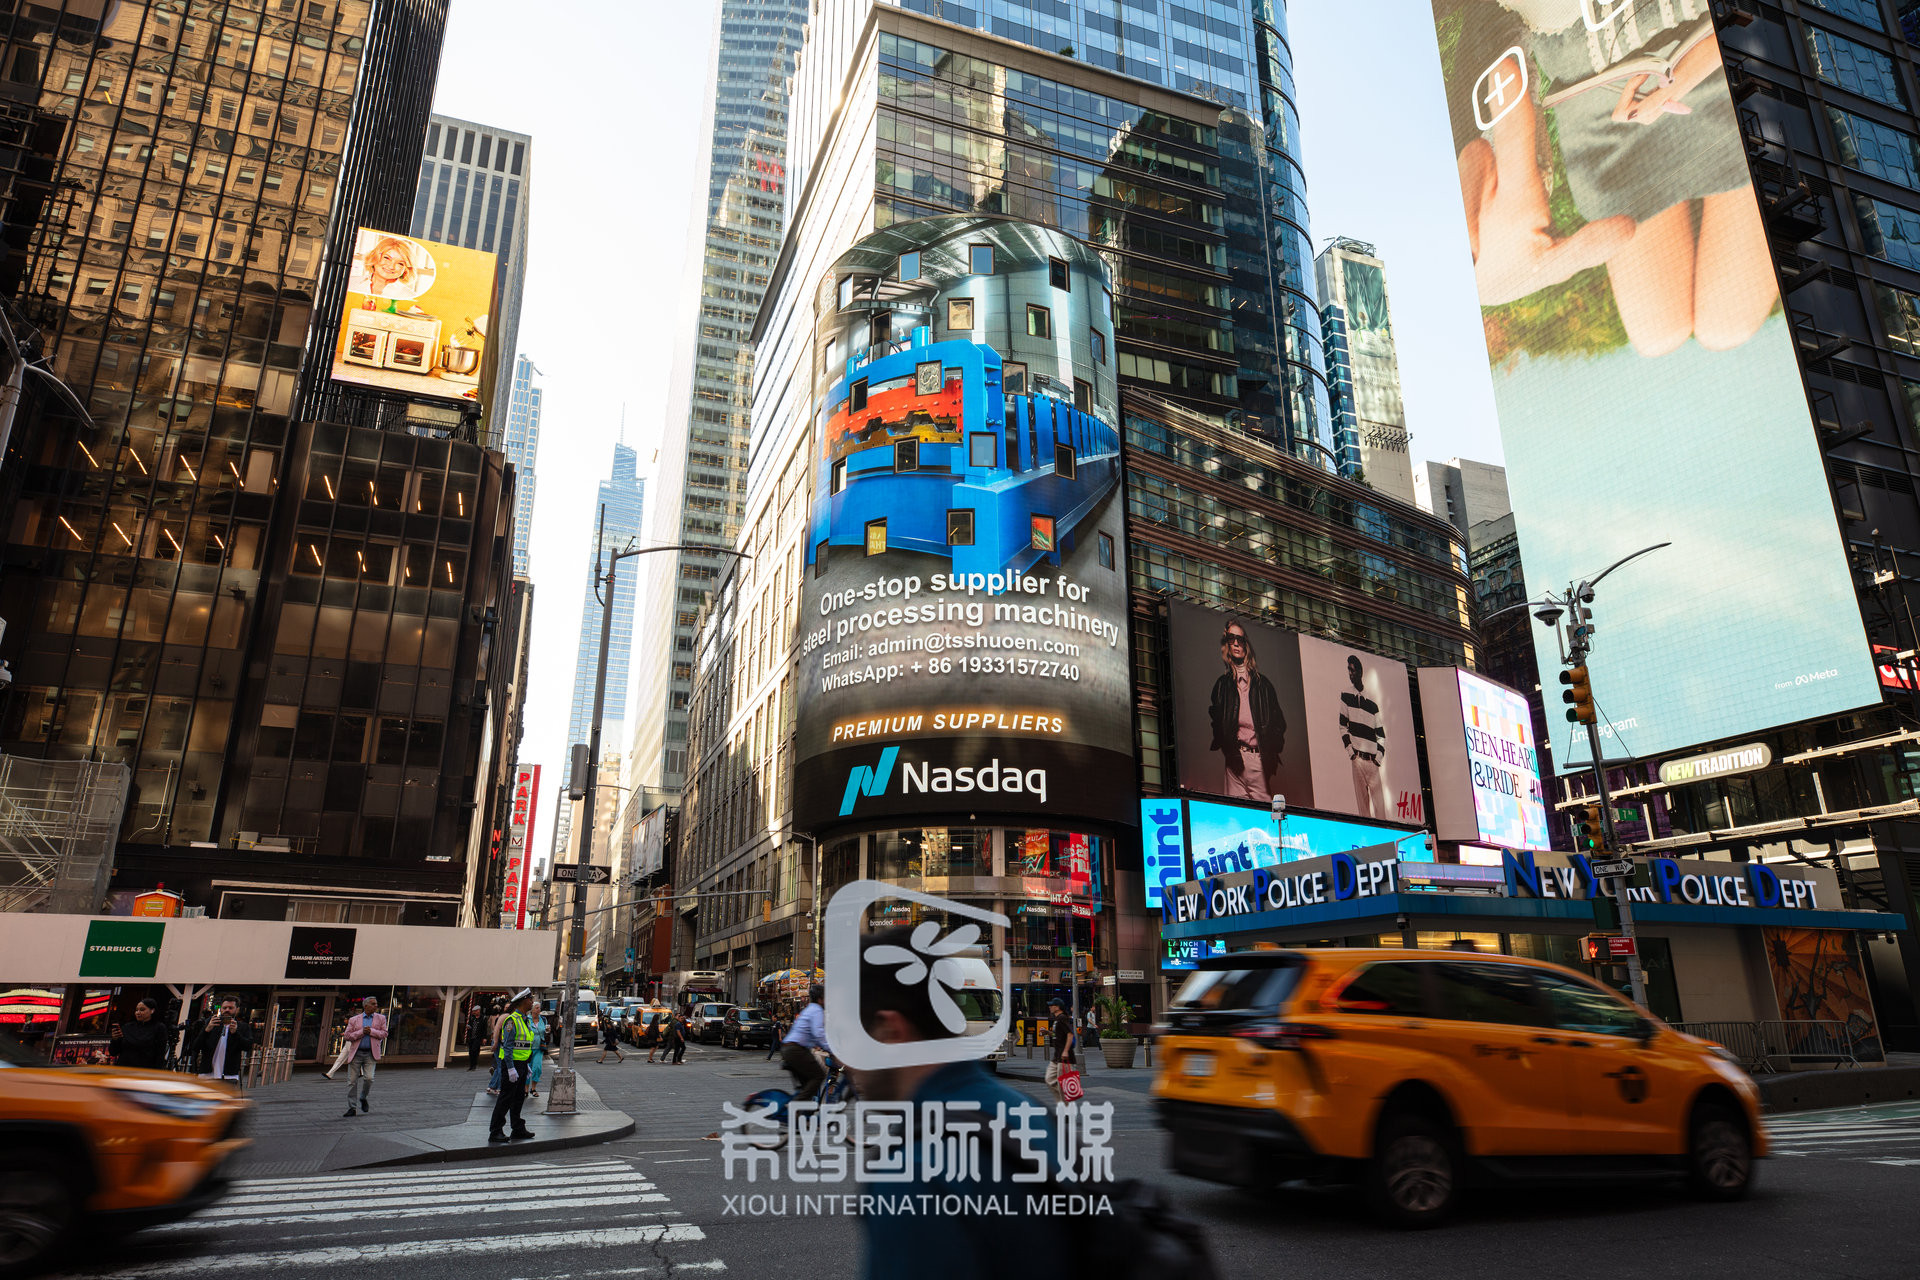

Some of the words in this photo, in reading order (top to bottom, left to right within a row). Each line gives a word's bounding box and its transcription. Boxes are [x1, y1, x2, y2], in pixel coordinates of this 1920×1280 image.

[820, 574, 922, 615] One-stop
[930, 569, 1050, 596] supplier
[1056, 575, 1090, 603] for
[802, 622, 831, 656] steel
[836, 599, 984, 642] processing
[994, 602, 1119, 646] machinery
[822, 646, 863, 669] Email:
[868, 633, 1080, 657] admin@tsshuoen.com
[821, 664, 904, 693] WhatsApp:
[928, 657, 952, 674] 86
[959, 656, 1080, 681] 19331572740
[1774, 680, 1792, 690] from
[1809, 668, 1838, 681] Meta
[832, 715, 924, 742] PREMIUM
[932, 713, 1063, 733] SUPPLIERS
[1572, 717, 1638, 743] Insagram
[514, 772, 531, 825] PARK
[902, 758, 1048, 803] Nasdaq
[1397, 790, 1422, 822] H&M
[504, 857, 520, 912] PARK
[1503, 848, 1575, 898] NEW
[1656, 859, 1750, 906] POLICE
[1751, 864, 1818, 908] DEPT
[1596, 866, 1608, 874] ONE
[1616, 863, 1628, 872] WAY
[1162, 886, 1198, 924] NEW
[1199, 878, 1250, 918] YORK
[1253, 869, 1325, 911] POLICE
[1332, 853, 1398, 900] DEPT
[1027, 905, 1046, 914] Nasdaq
